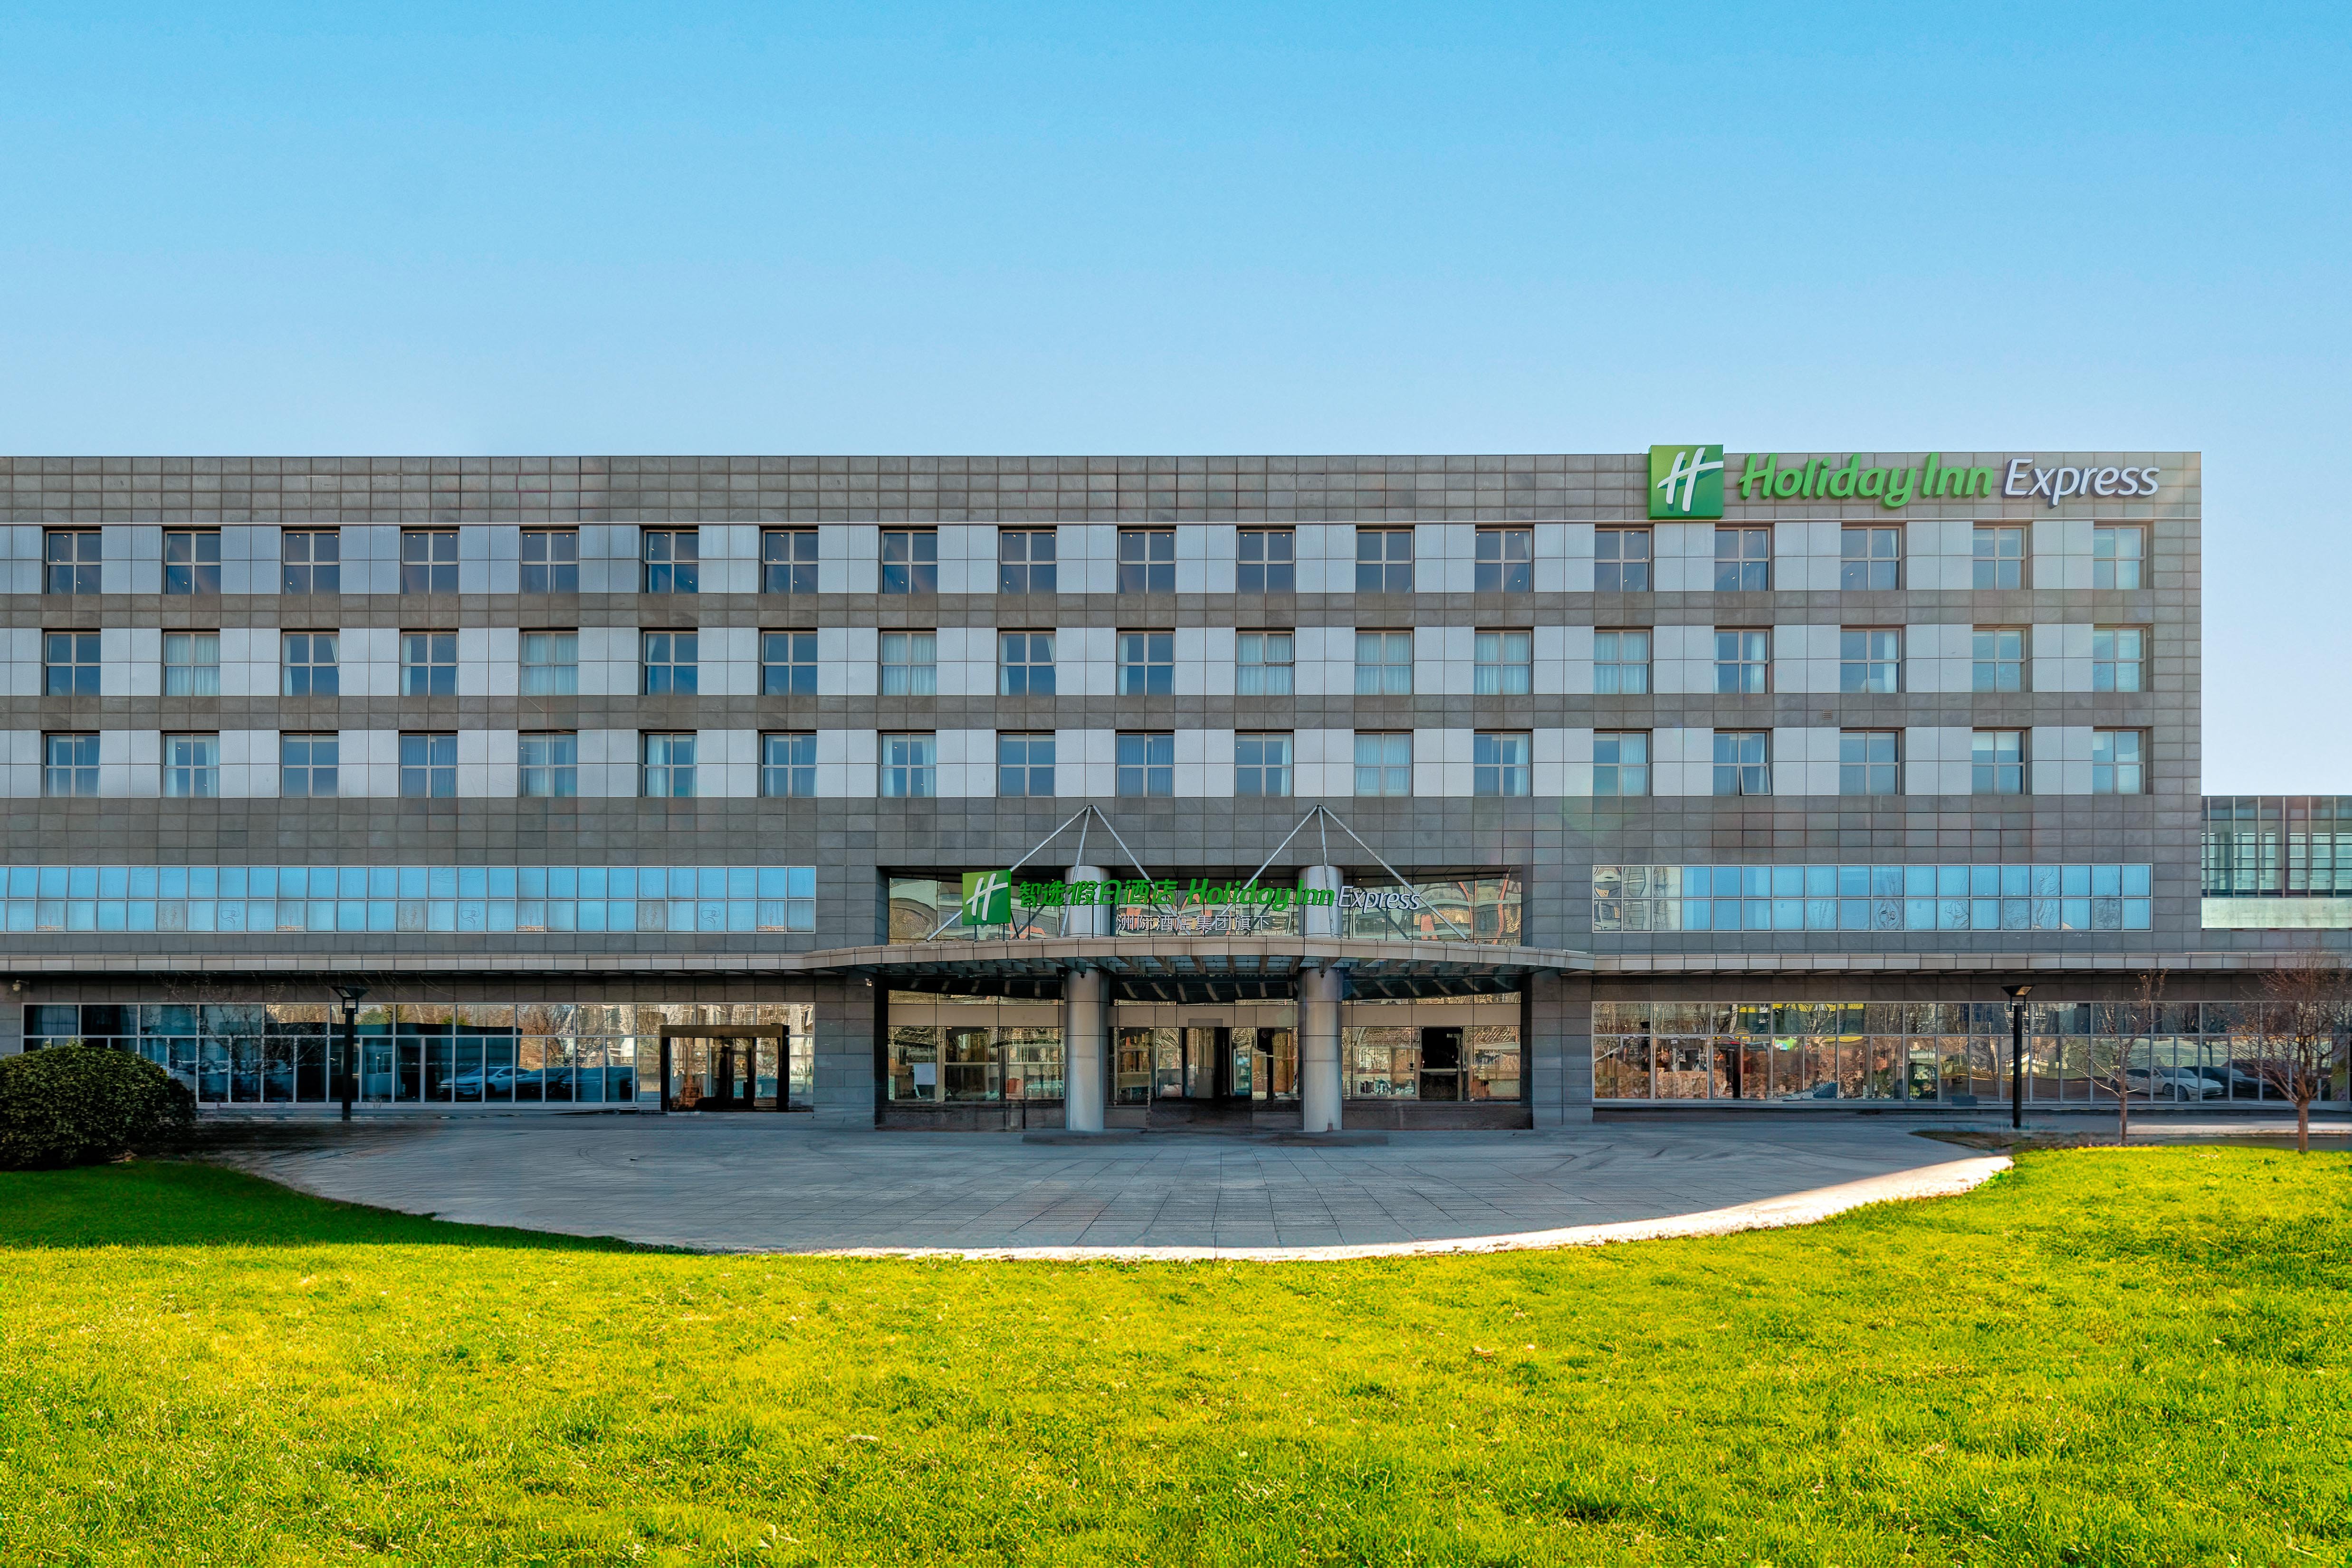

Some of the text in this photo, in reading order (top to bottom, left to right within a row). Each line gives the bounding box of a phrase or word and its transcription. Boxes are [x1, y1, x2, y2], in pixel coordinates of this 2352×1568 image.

[1737, 452, 1917, 508] Holiday
[1920, 452, 1994, 497] Inn
[2002, 458, 2161, 508] Express
[1018, 879, 1178, 908] 智选假日酒店
[1186, 878, 1421, 914] Holiday Inn Express
[1117, 914, 1270, 931] 洲际酒店集团旗下
